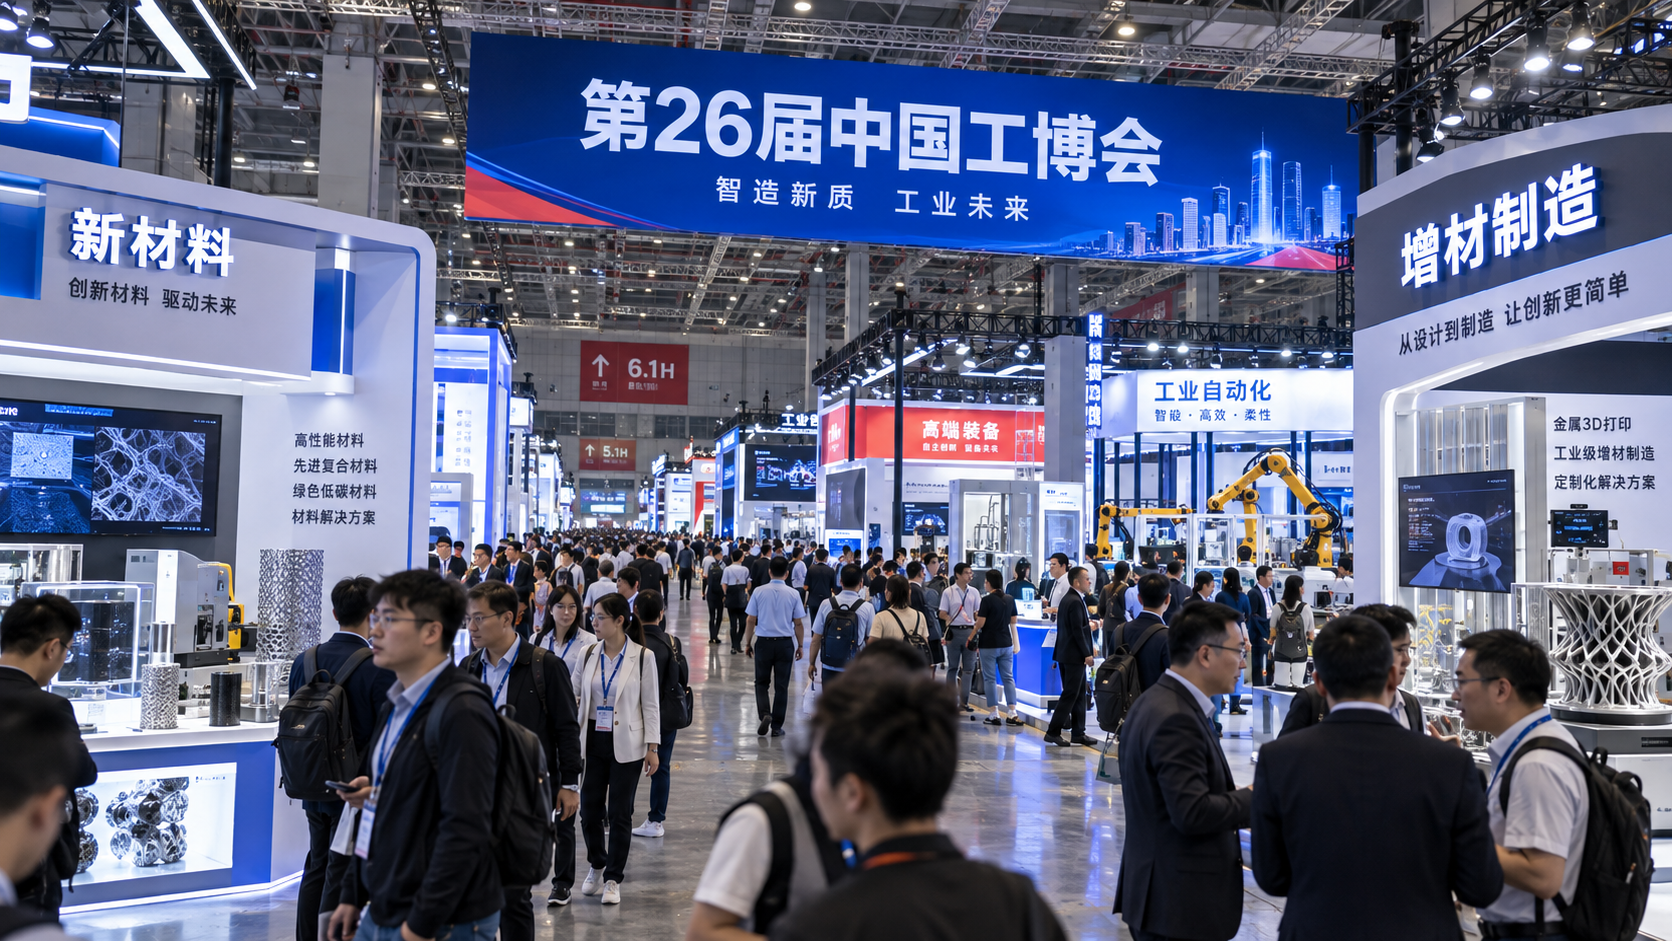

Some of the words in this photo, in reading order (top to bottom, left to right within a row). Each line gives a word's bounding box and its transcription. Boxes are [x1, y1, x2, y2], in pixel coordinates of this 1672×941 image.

[580, 78, 1162, 187] 第26届中国工博会
[715, 176, 854, 210] 智造新质
[895, 189, 1030, 222] 工业未来
[1400, 163, 1598, 288] 增材制造
[69, 207, 234, 277] 新材料
[68, 276, 150, 307] 创新材料
[162, 287, 237, 316] 驱动未来
[1399, 309, 1495, 356] 从设计到制造
[1505, 270, 1629, 327] 让创新更简单
[628, 358, 675, 379] 6.1H
[1154, 379, 1271, 402] 工业自动化
[922, 419, 1000, 441] 高端装备
[1553, 416, 1632, 432] 金属3D打印
[294, 432, 365, 448] 高性能材料
[602, 445, 628, 458] 5.1H
[1554, 445, 1655, 462] 工业级增材制造
[293, 457, 378, 475] 先进复合材料
[292, 483, 377, 500] 绿色低碳材料
[1554, 474, 1656, 491] 定制化解决方案
[291, 508, 376, 526] 材料解决方案
